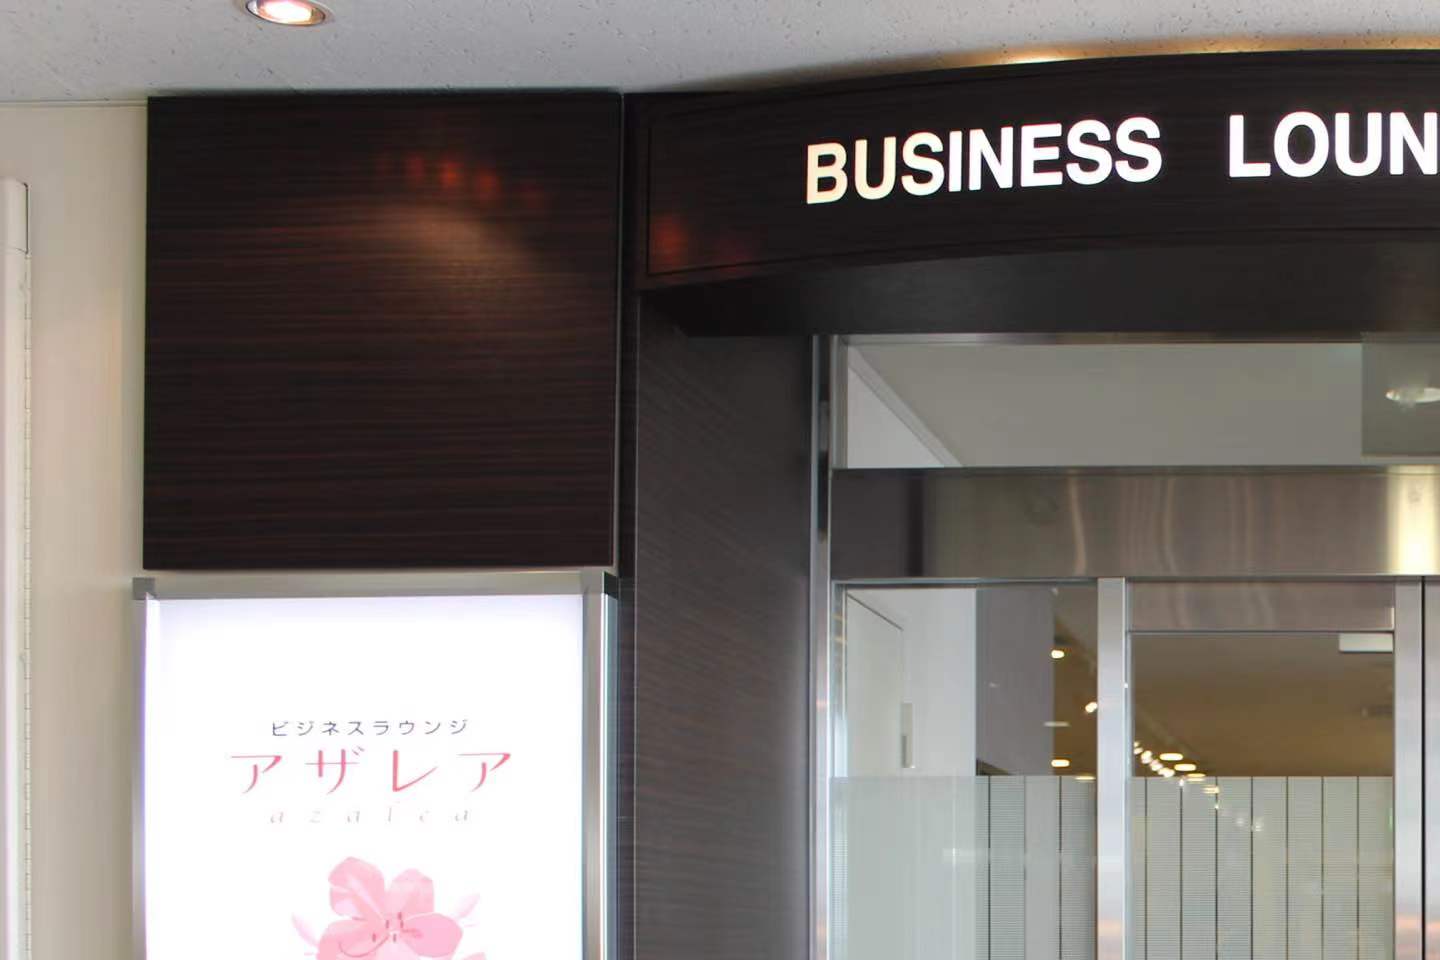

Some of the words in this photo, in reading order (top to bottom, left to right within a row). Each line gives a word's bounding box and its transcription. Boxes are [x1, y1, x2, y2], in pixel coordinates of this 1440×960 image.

[805, 117, 1163, 205] BUSINESS
[271, 719, 468, 736] ビジネスラウンジ
[229, 746, 511, 795] アザレア
